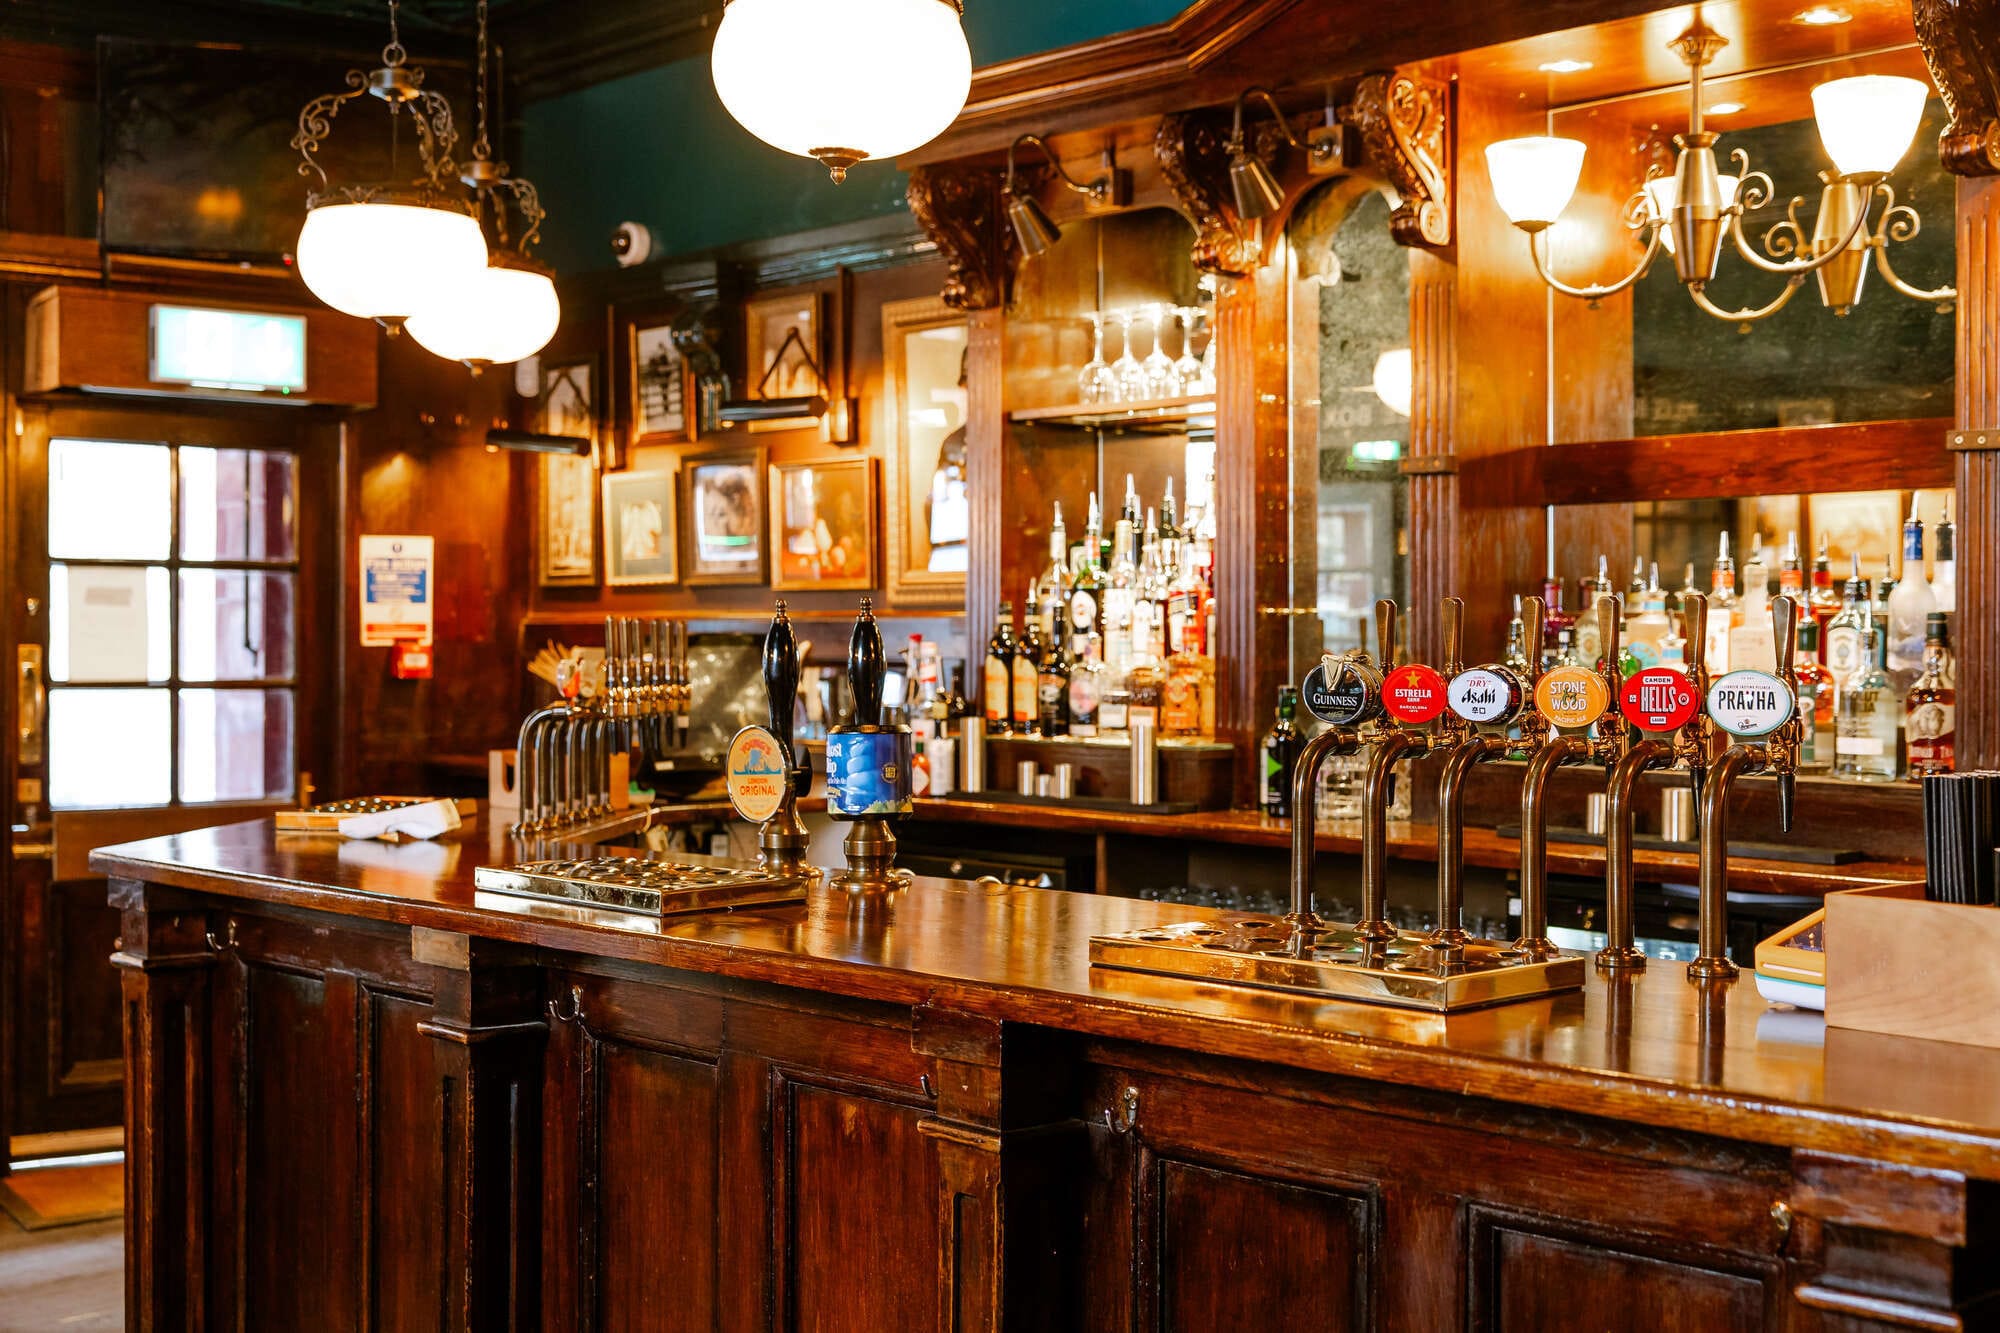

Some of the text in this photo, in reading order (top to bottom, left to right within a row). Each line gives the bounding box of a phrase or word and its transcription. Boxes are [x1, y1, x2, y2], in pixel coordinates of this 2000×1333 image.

[1395, 688, 1432, 698] ESTRELLA
[1550, 681, 1587, 694] STONE
[1313, 692, 1358, 707] GUINNESS
[1461, 687, 1496, 704] Asahi
[1640, 686, 1677, 713] HELLS
[1718, 690, 1776, 710] PRAVHA
[1551, 698, 1587, 710] WOOD
[740, 785, 777, 796] ORIGINAL
